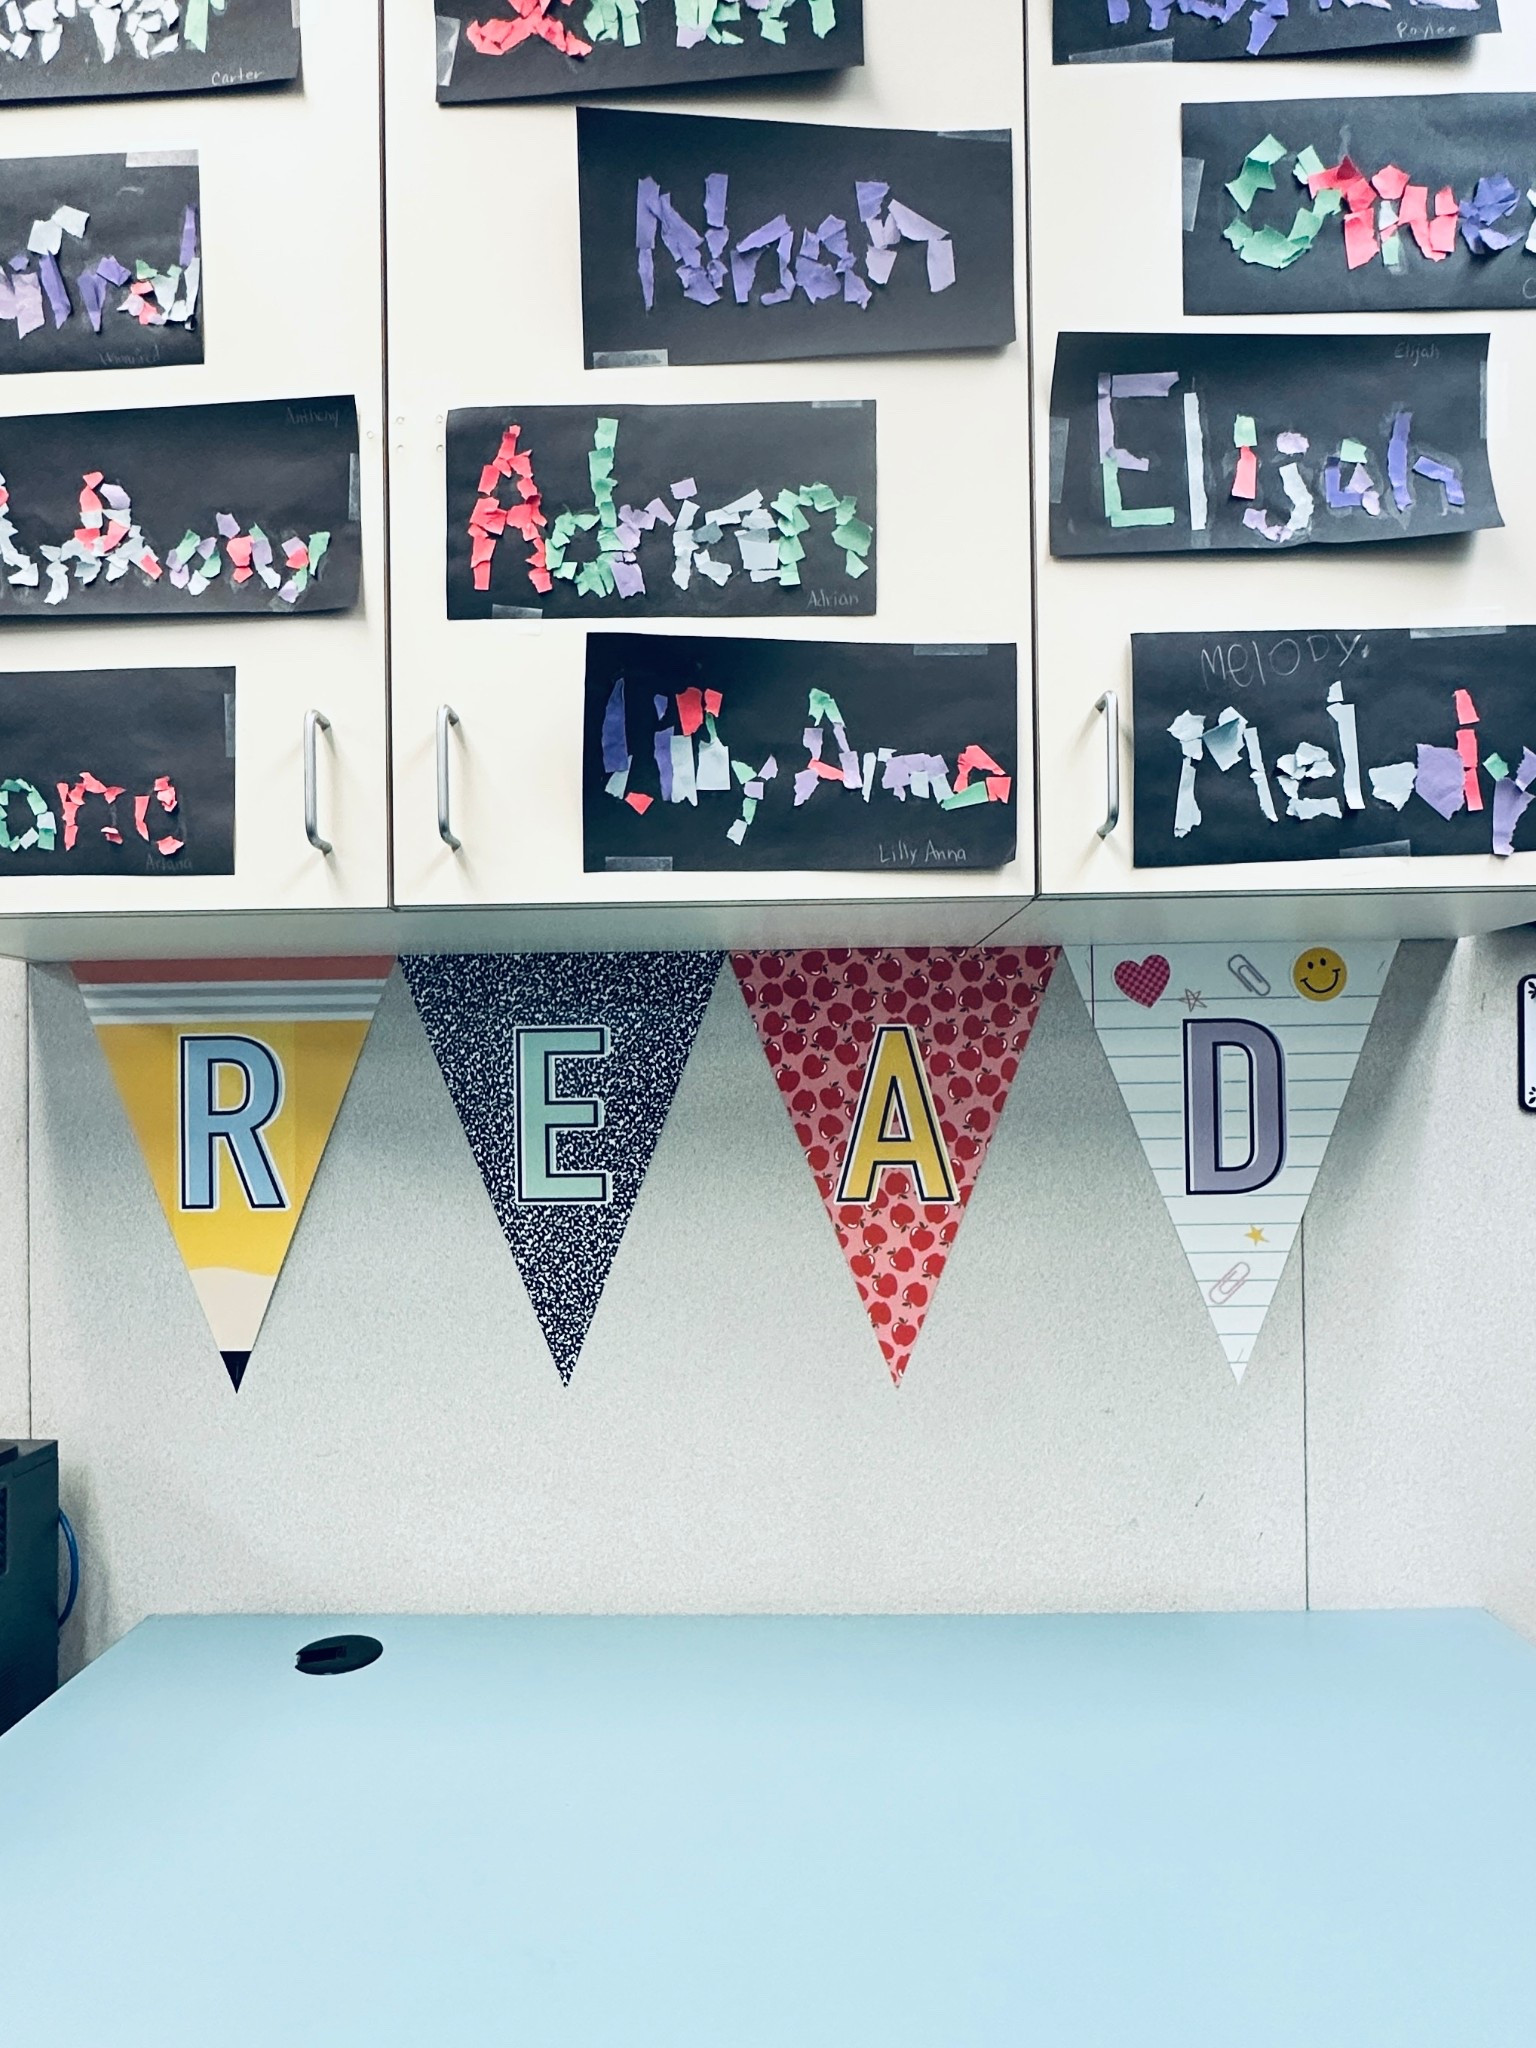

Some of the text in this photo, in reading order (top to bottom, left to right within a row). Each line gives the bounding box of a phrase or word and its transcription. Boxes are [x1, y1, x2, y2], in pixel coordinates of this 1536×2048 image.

[211, 67, 264, 86] Carter
[1394, 342, 1440, 367] Elijah
[1097, 371, 1466, 543] Elijah
[468, 417, 875, 600] Adrian
[806, 588, 860, 609] Adrian
[879, 839, 968, 865] Lilly Anna
